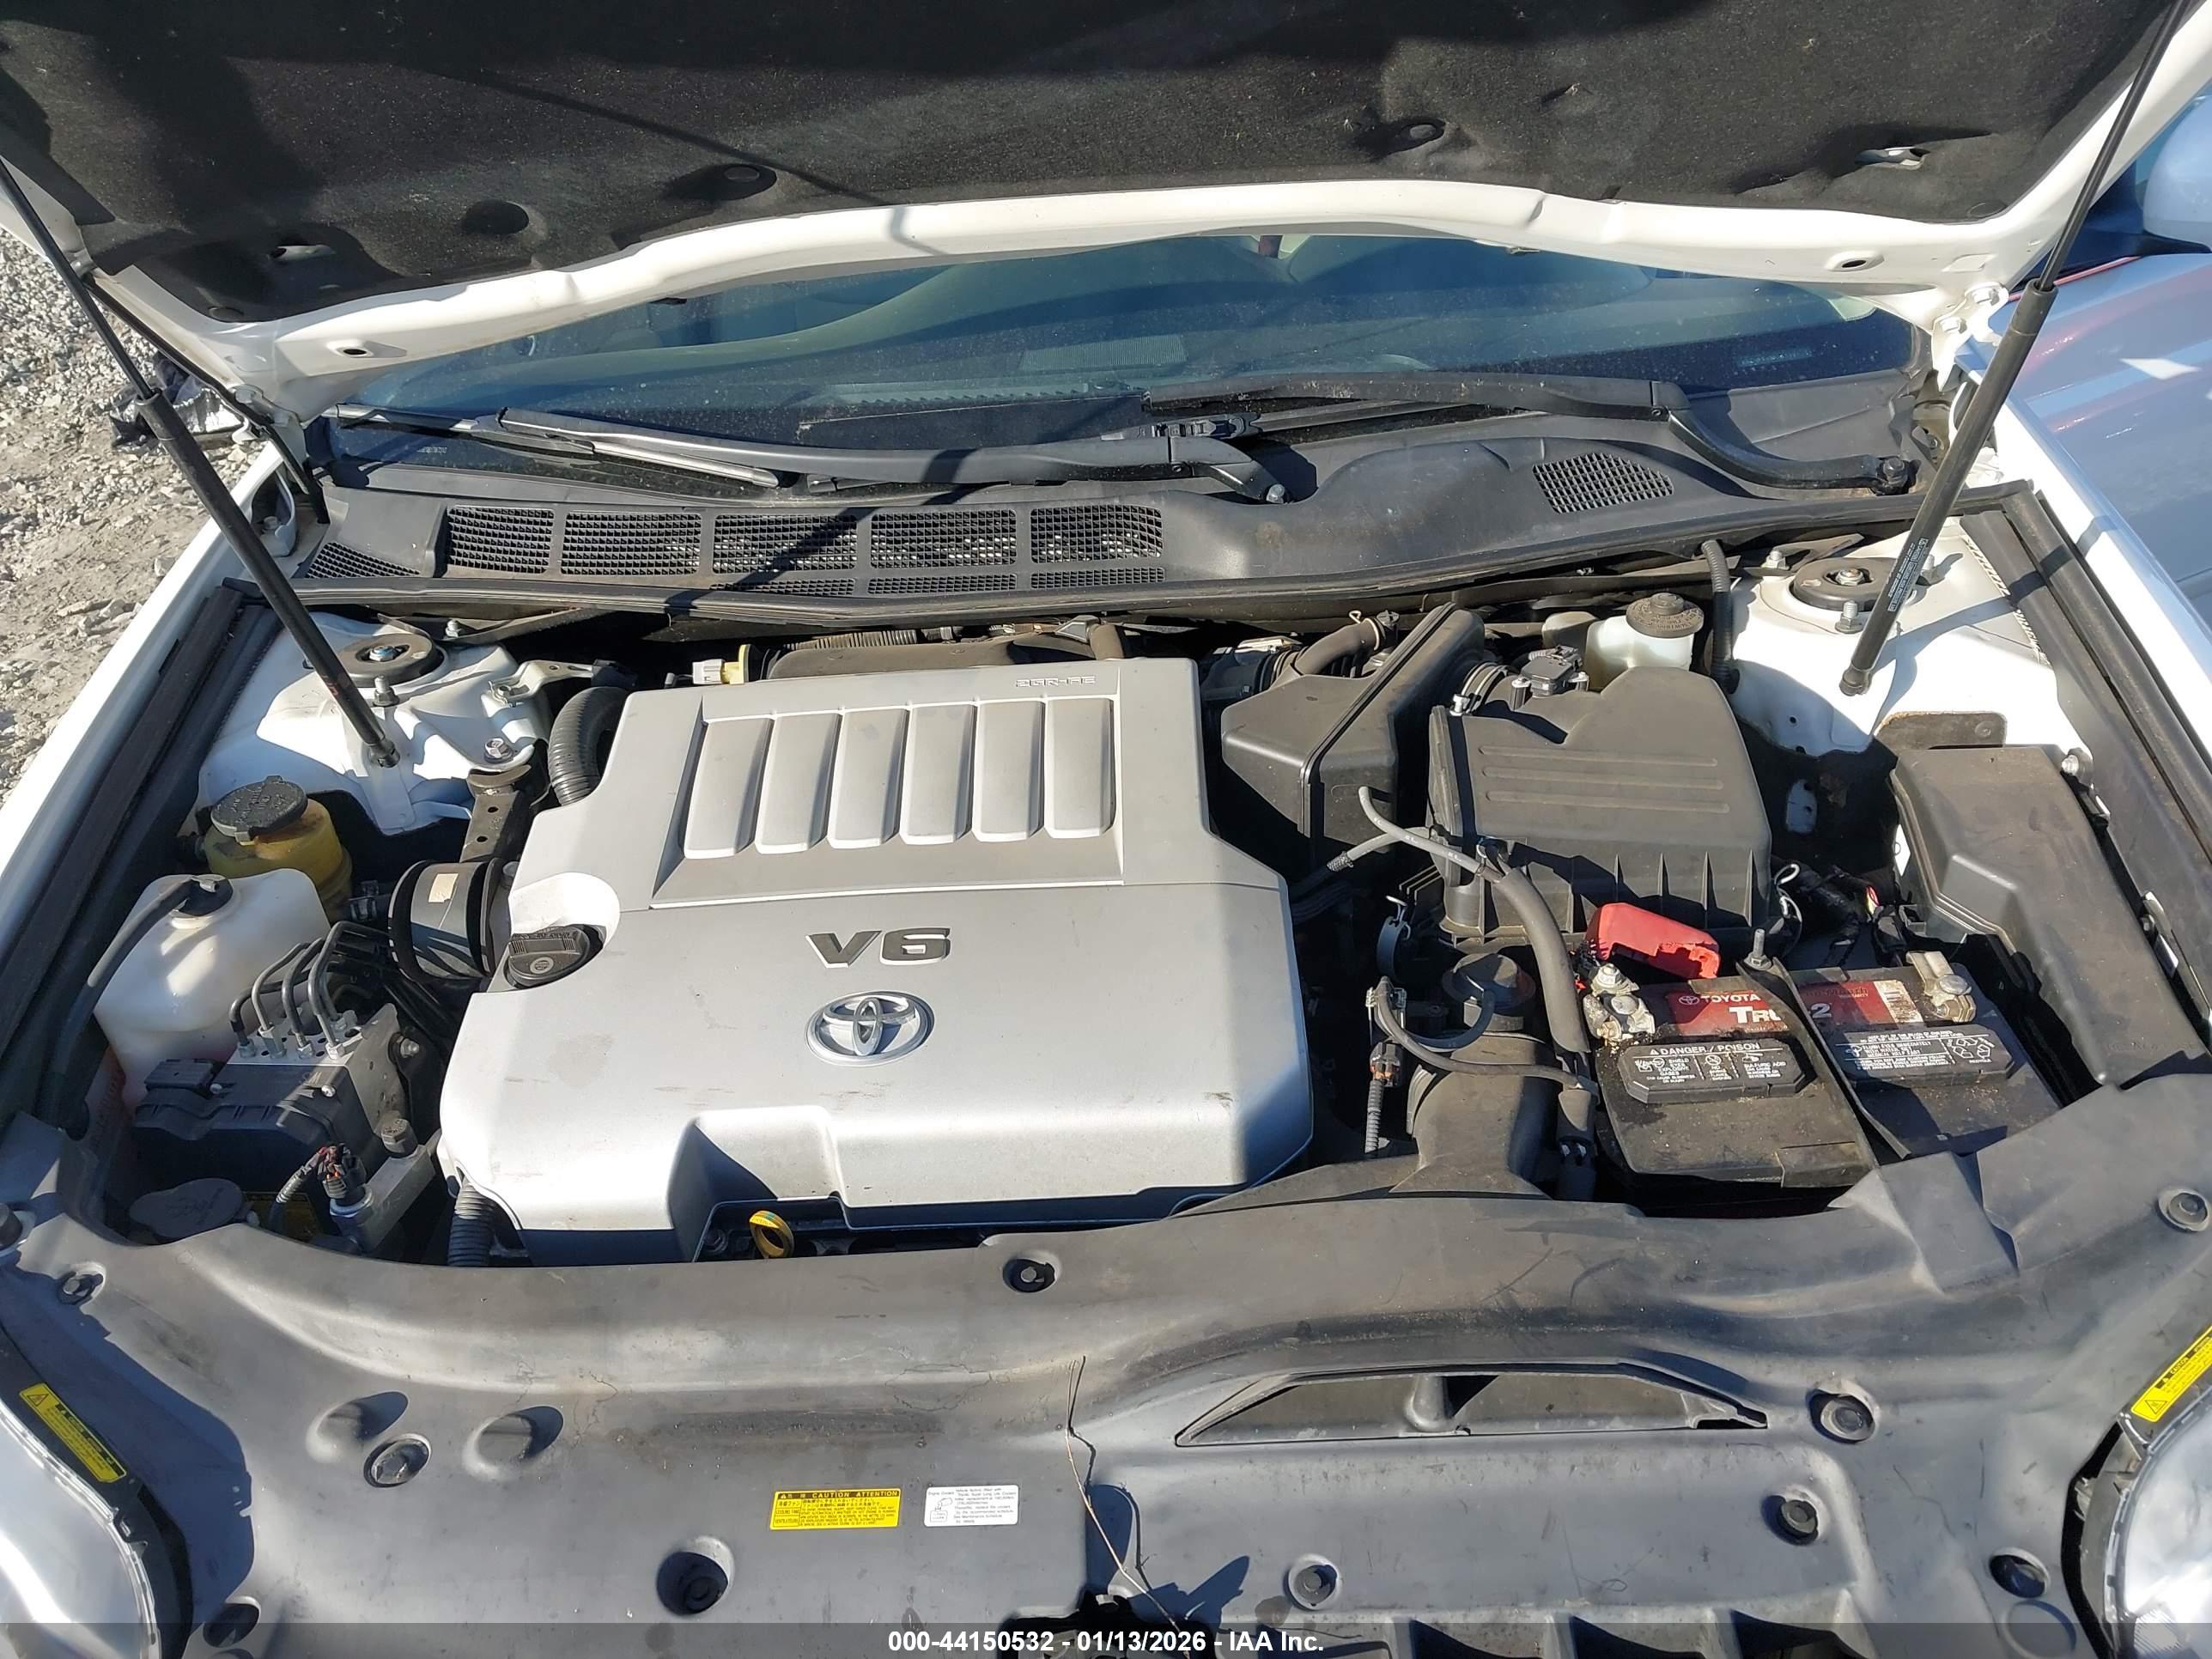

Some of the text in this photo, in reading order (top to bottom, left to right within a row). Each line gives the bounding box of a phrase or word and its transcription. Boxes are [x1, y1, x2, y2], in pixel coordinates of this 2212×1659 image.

[805, 926, 951, 969] V6
[1700, 993, 1761, 1003] TOYOTA
[1661, 1046, 1706, 1055] DANGER
[1717, 1042, 1760, 1052] POISON
